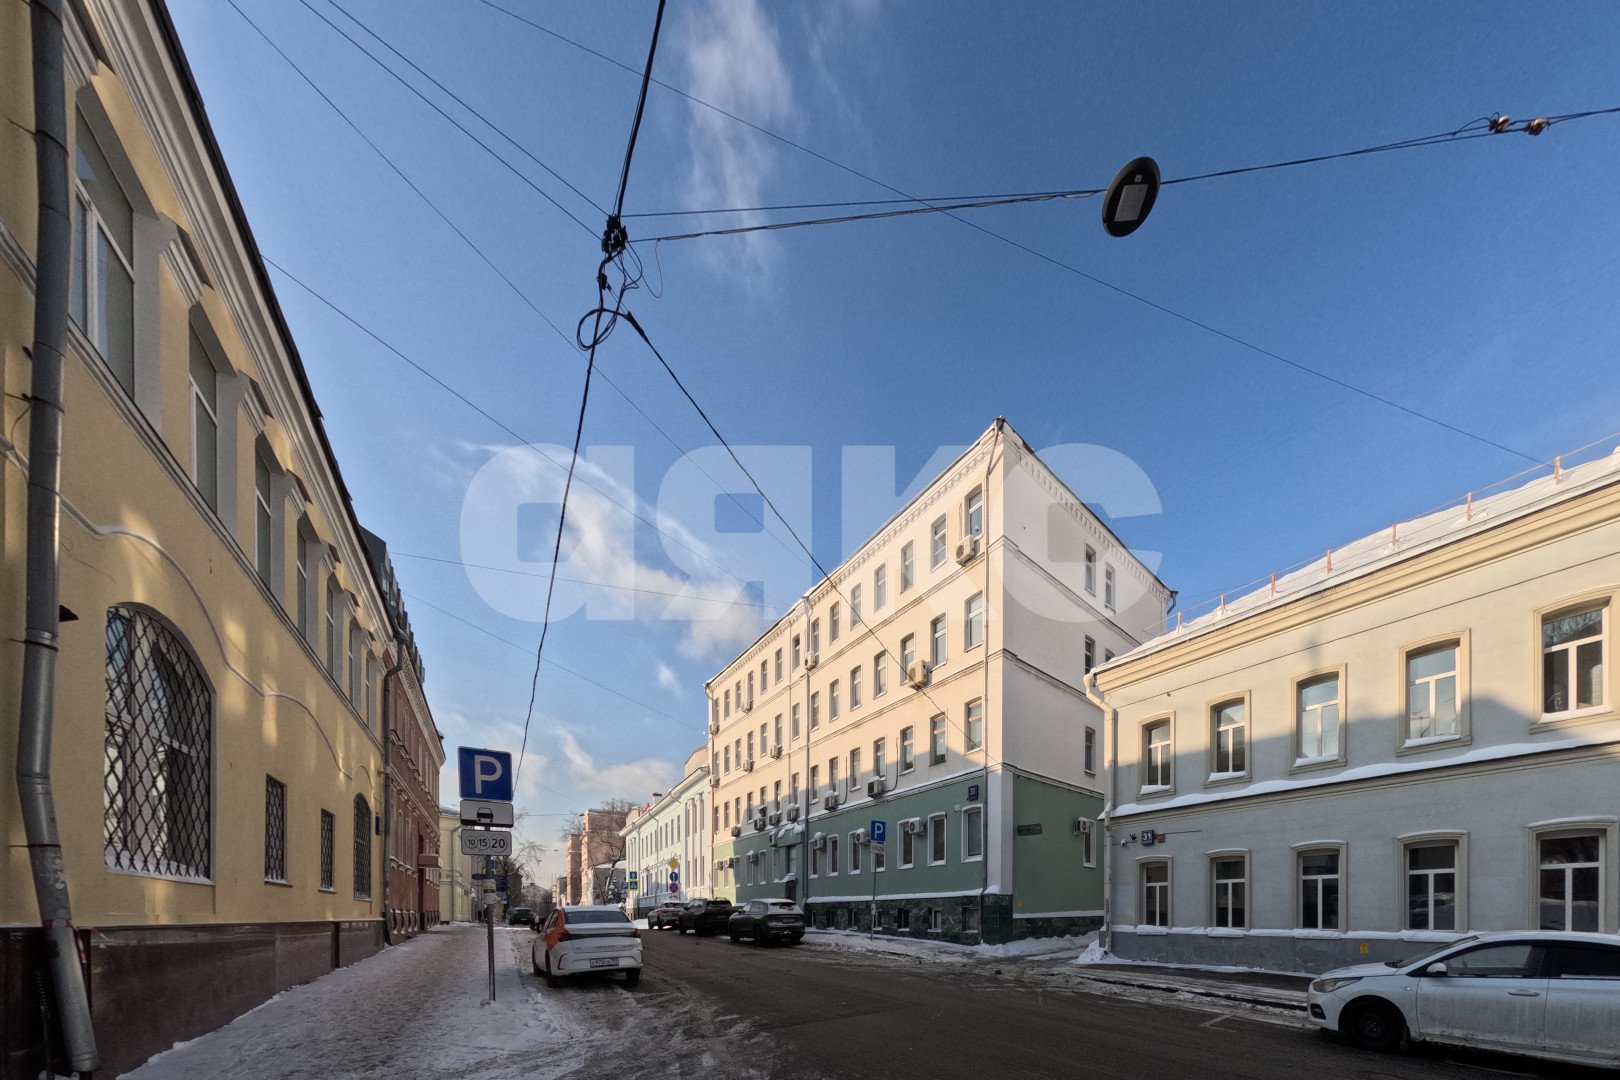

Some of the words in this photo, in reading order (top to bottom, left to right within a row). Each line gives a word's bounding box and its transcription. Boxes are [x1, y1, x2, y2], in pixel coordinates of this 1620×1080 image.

[474, 754, 503, 794] P
[874, 822, 884, 839] P
[1142, 832, 1152, 841] 31
[479, 838, 488, 848] 15
[491, 838, 506, 849] 20
